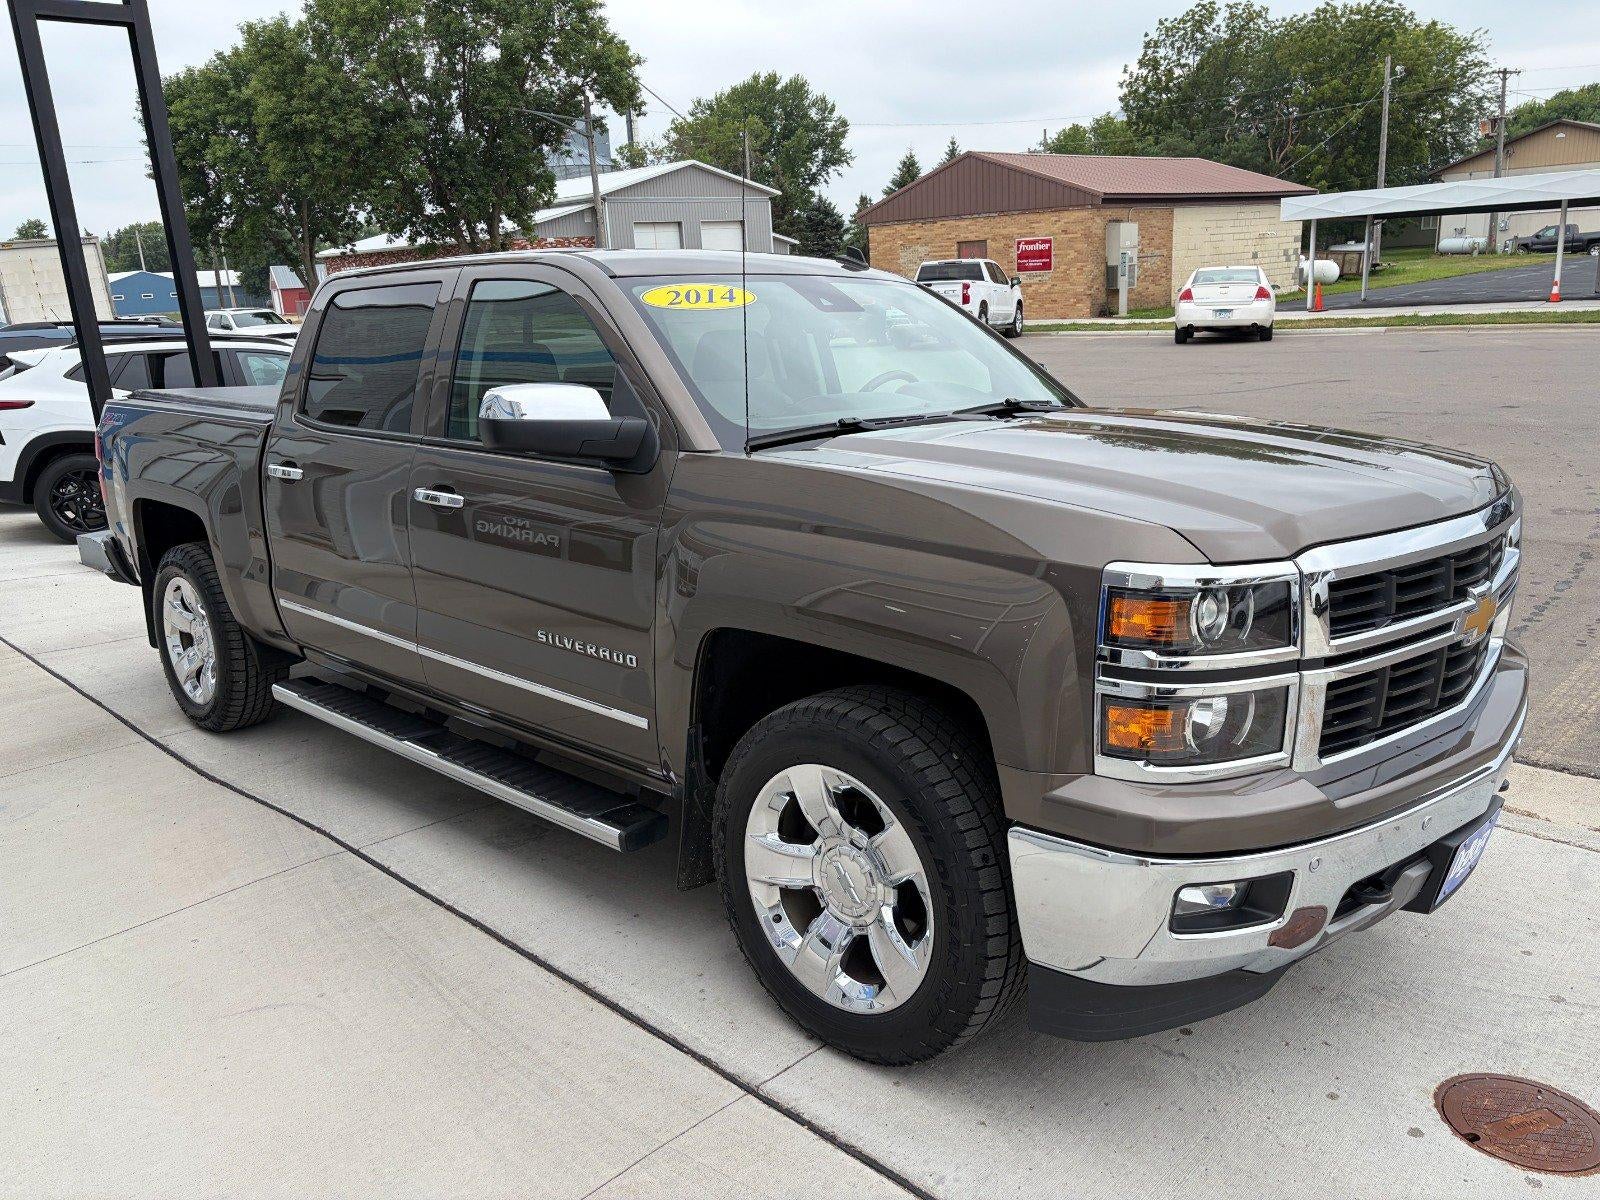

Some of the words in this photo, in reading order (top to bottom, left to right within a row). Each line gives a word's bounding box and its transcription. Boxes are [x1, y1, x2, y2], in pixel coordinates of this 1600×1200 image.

[1017, 241, 1050, 254] frontier
[666, 288, 736, 306] 2014
[537, 628, 638, 668] SILVERADO
